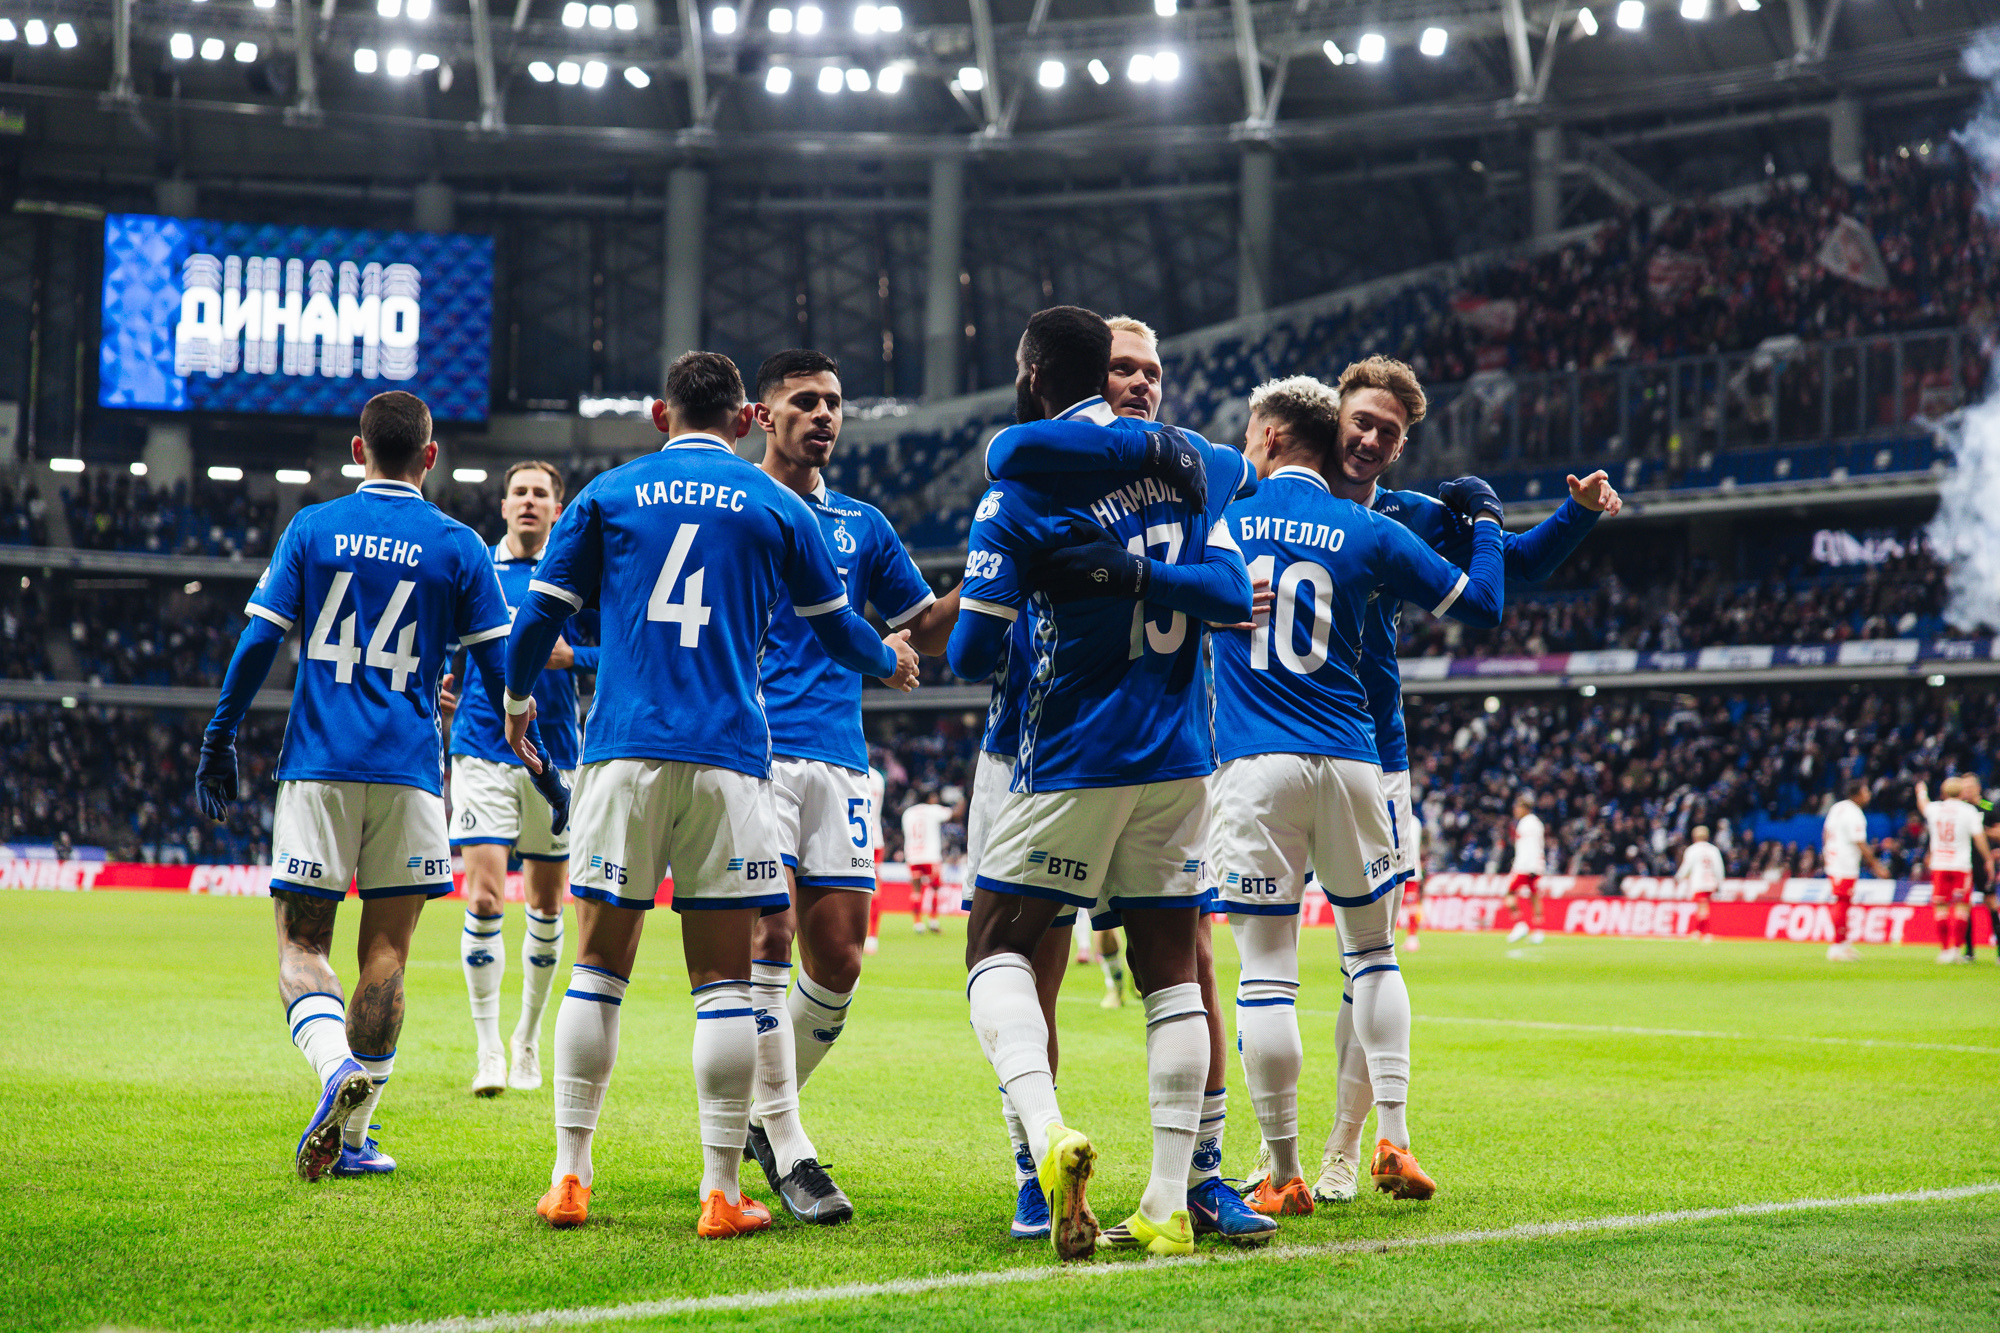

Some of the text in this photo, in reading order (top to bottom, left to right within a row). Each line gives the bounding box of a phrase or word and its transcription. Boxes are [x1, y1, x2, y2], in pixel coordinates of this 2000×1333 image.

[175, 281, 421, 352] ДИНАМО
[635, 480, 747, 512] КАСЕРЕС
[816, 503, 862, 517] CHANGAN
[1240, 516, 1345, 553] БИТЕЛЛО
[334, 534, 423, 568] РУБЕНС
[647, 523, 711, 648] 4
[1247, 555, 1333, 675] 10
[307, 571, 421, 692] 44
[0, 860, 105, 891] ONBET
[287, 857, 322, 879] ВТБ
[425, 859, 451, 876] ВТБ
[604, 862, 628, 885] ВТБ
[747, 860, 777, 880] ВТБ
[851, 857, 875, 869] BOSC
[1048, 856, 1089, 881] ВТБ
[1242, 877, 1277, 895] ВТБ
[1420, 897, 1500, 930] NBET
[1564, 899, 1698, 936] FONBET
[1766, 903, 1915, 943] FONBET
